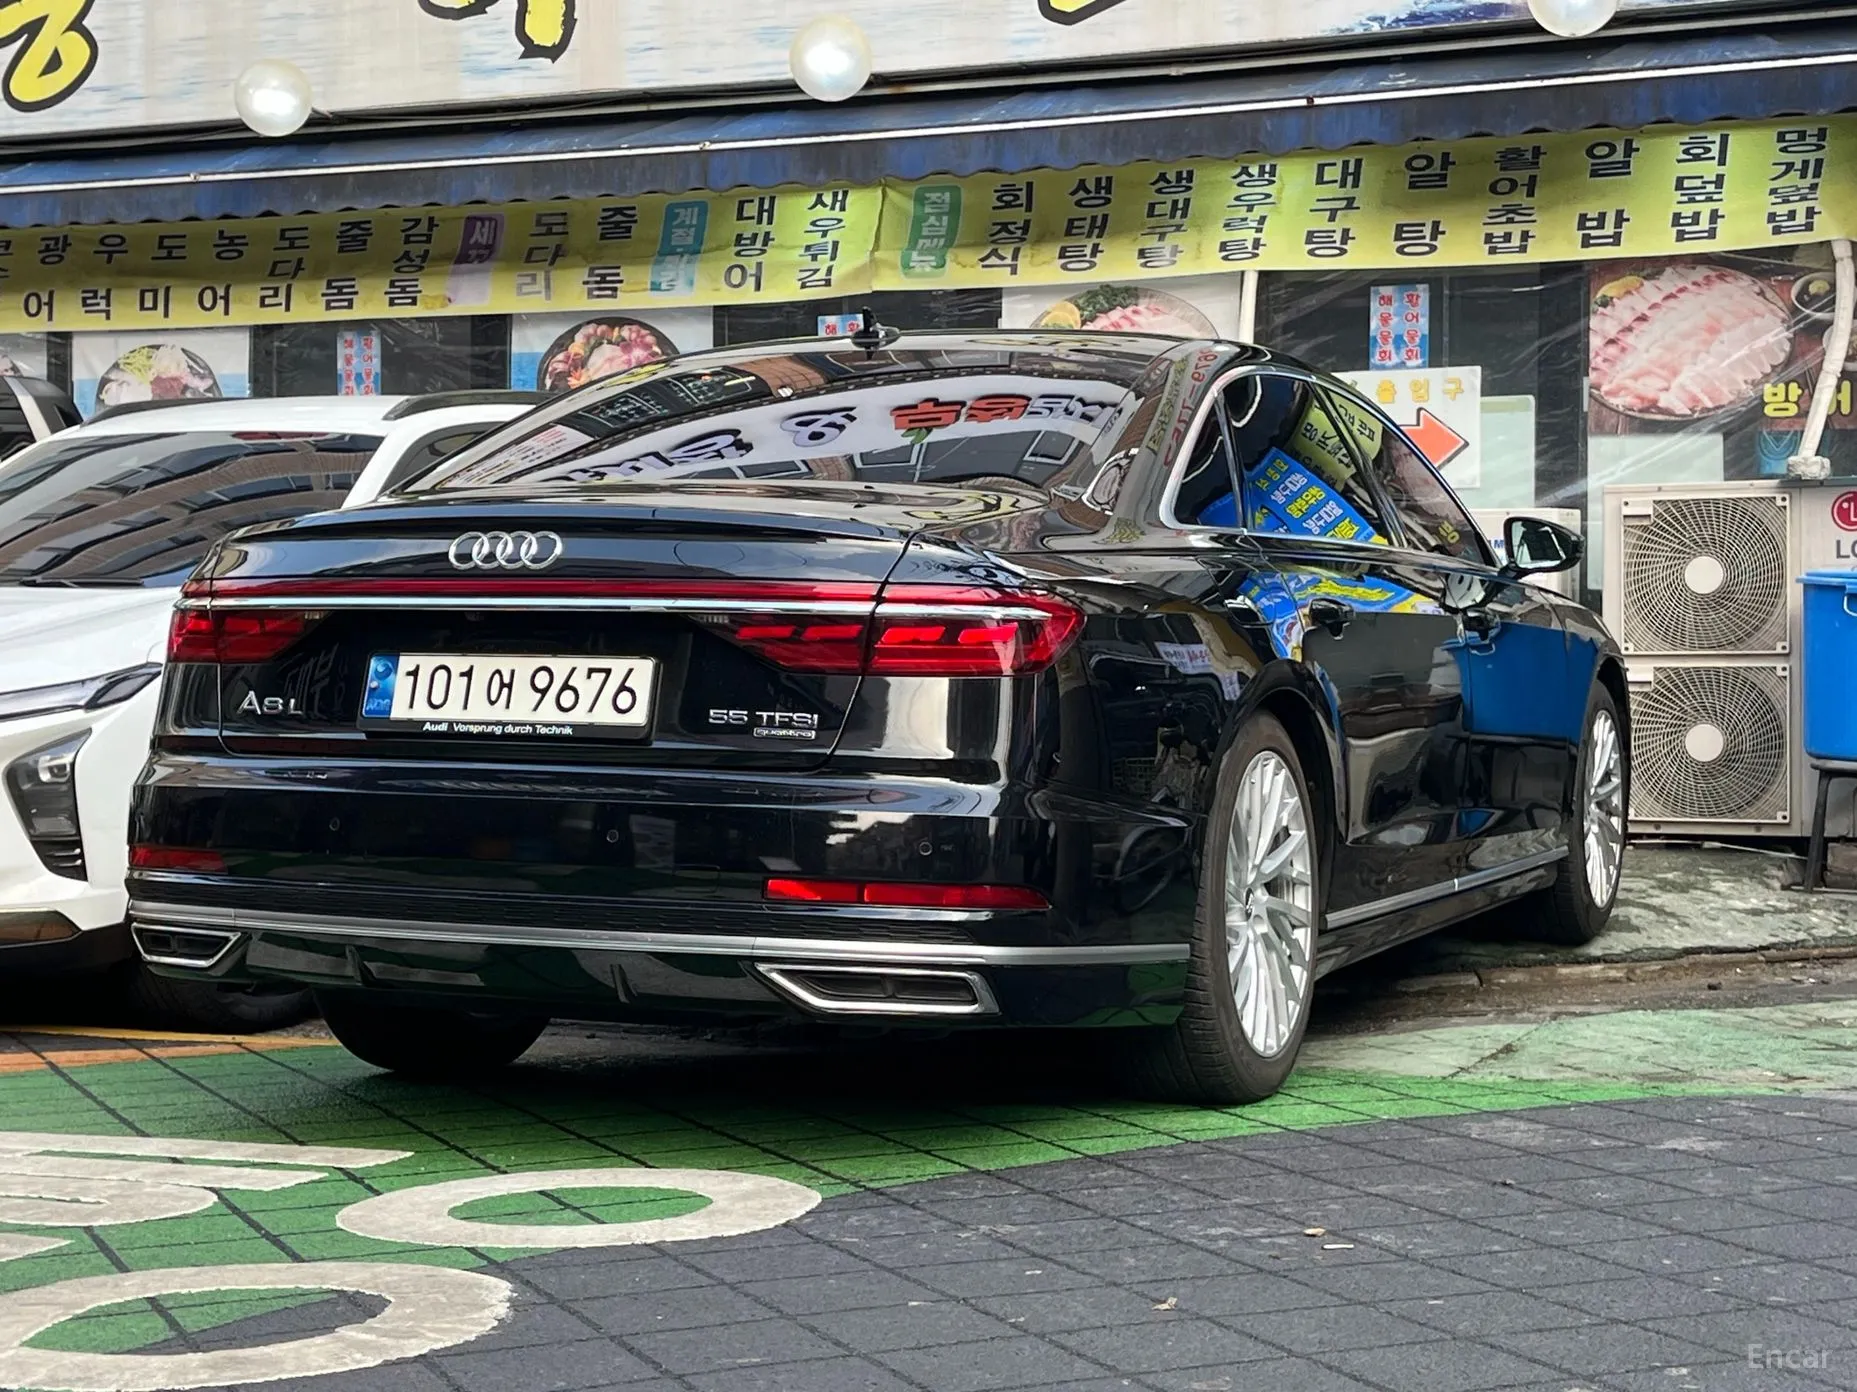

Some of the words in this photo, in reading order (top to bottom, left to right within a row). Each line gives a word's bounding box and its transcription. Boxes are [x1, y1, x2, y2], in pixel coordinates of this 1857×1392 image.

[978, 181, 1034, 276] 회정식
[1058, 175, 1113, 272] 생태탕
[1137, 169, 1195, 269] 생대구탕
[1218, 163, 1277, 262] 생우럭탕
[1304, 158, 1364, 258] 대구탕
[1393, 152, 1456, 257] 알탕
[1482, 145, 1547, 256] 활어초밥
[1577, 138, 1640, 249] 알밥
[1671, 133, 1730, 242] 회덮밥
[1766, 127, 1828, 236] 멍게덮밥
[24, 234, 72, 322] 광어
[81, 234, 129, 320] 우럭
[139, 234, 187, 318] 도미
[198, 229, 249, 316] 농어
[259, 226, 310, 312] 도다리
[321, 219, 374, 311] 줄돔
[384, 215, 440, 307] 감성돔
[516, 211, 569, 301] 도다리
[582, 205, 638, 300] 줄돔
[724, 195, 777, 292] 대방어
[797, 189, 849, 290] 새우튀김
[423, 722, 448, 732] Audi
[453, 722, 503, 736] Vorsprung
[504, 723, 533, 734] durch
[535, 724, 573, 736] Technik
[529, 665, 638, 715] 9676
[708, 708, 748, 725] 55
[755, 711, 819, 729] TFSI
